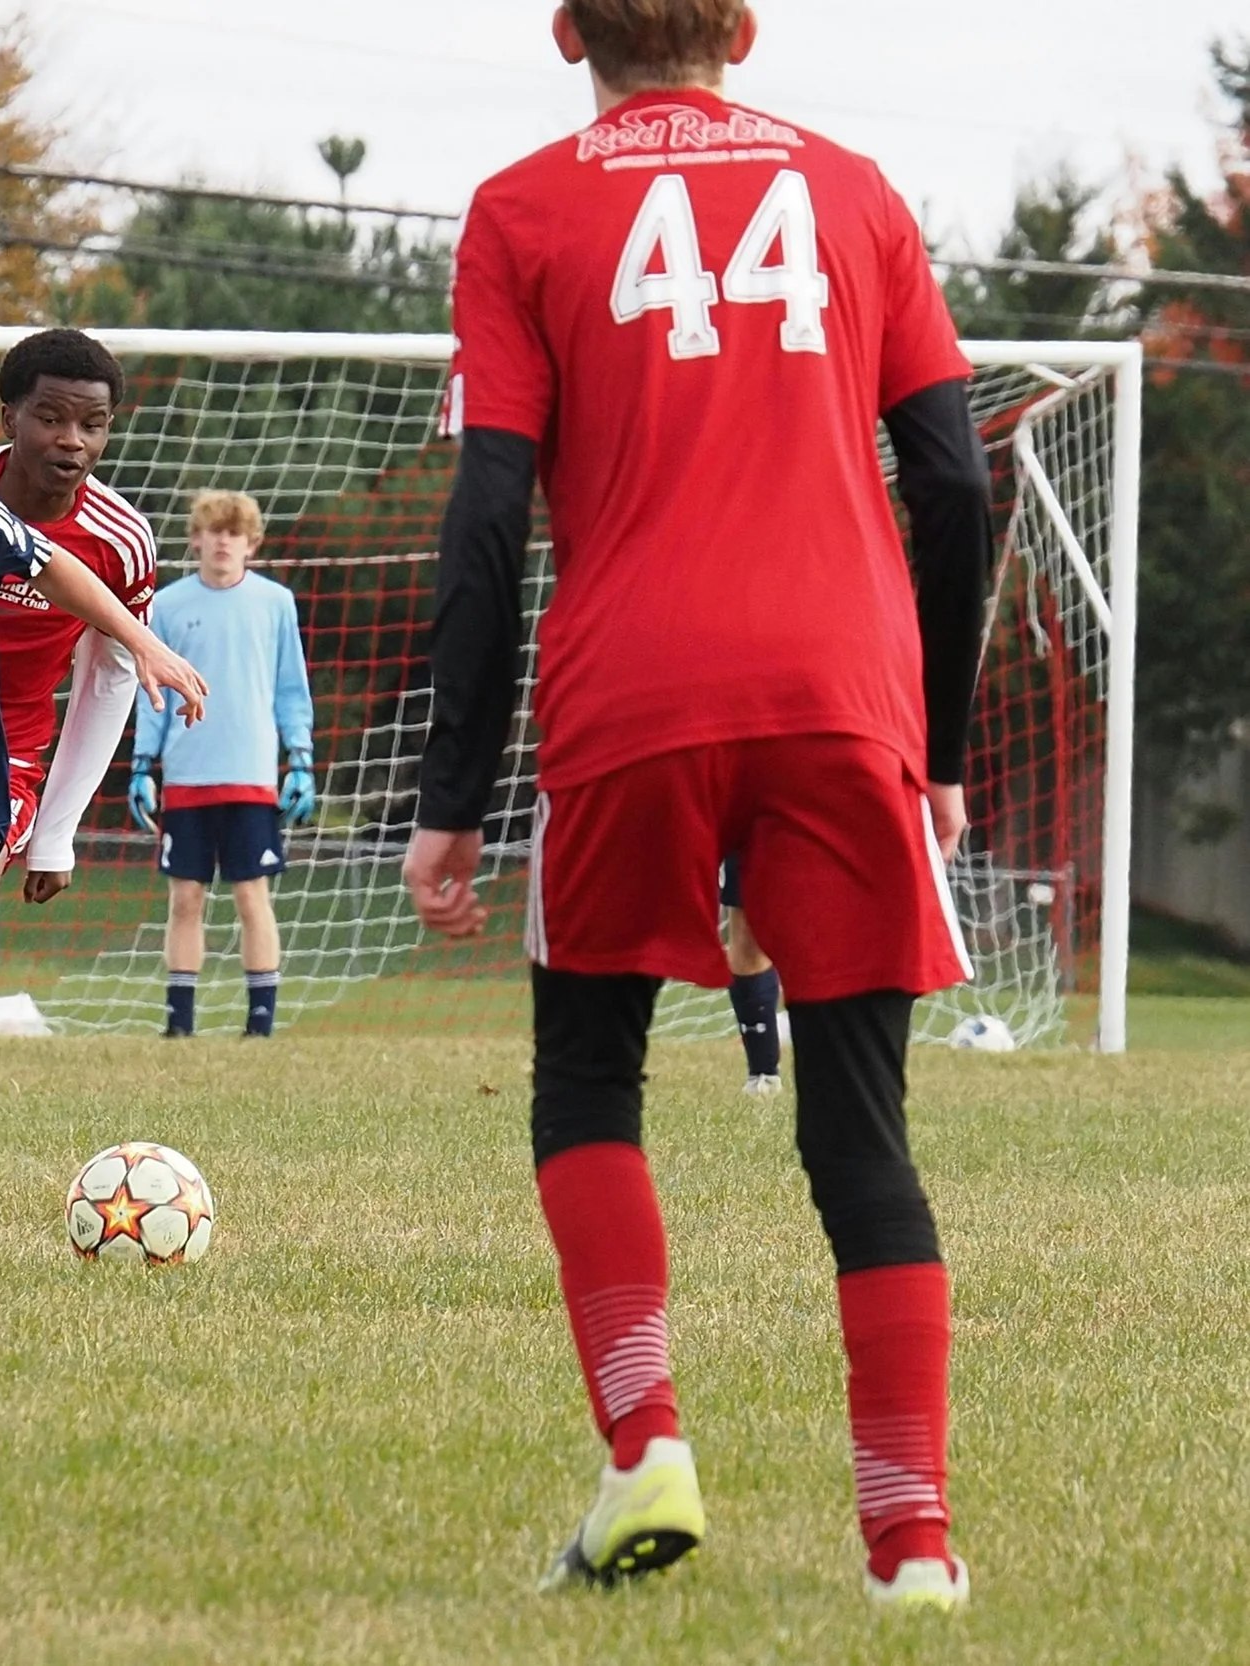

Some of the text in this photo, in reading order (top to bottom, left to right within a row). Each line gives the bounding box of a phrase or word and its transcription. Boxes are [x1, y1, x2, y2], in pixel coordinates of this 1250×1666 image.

[576, 105, 806, 163] Red Robin
[610, 169, 829, 360] 44
[21, 597, 50, 611] Club
